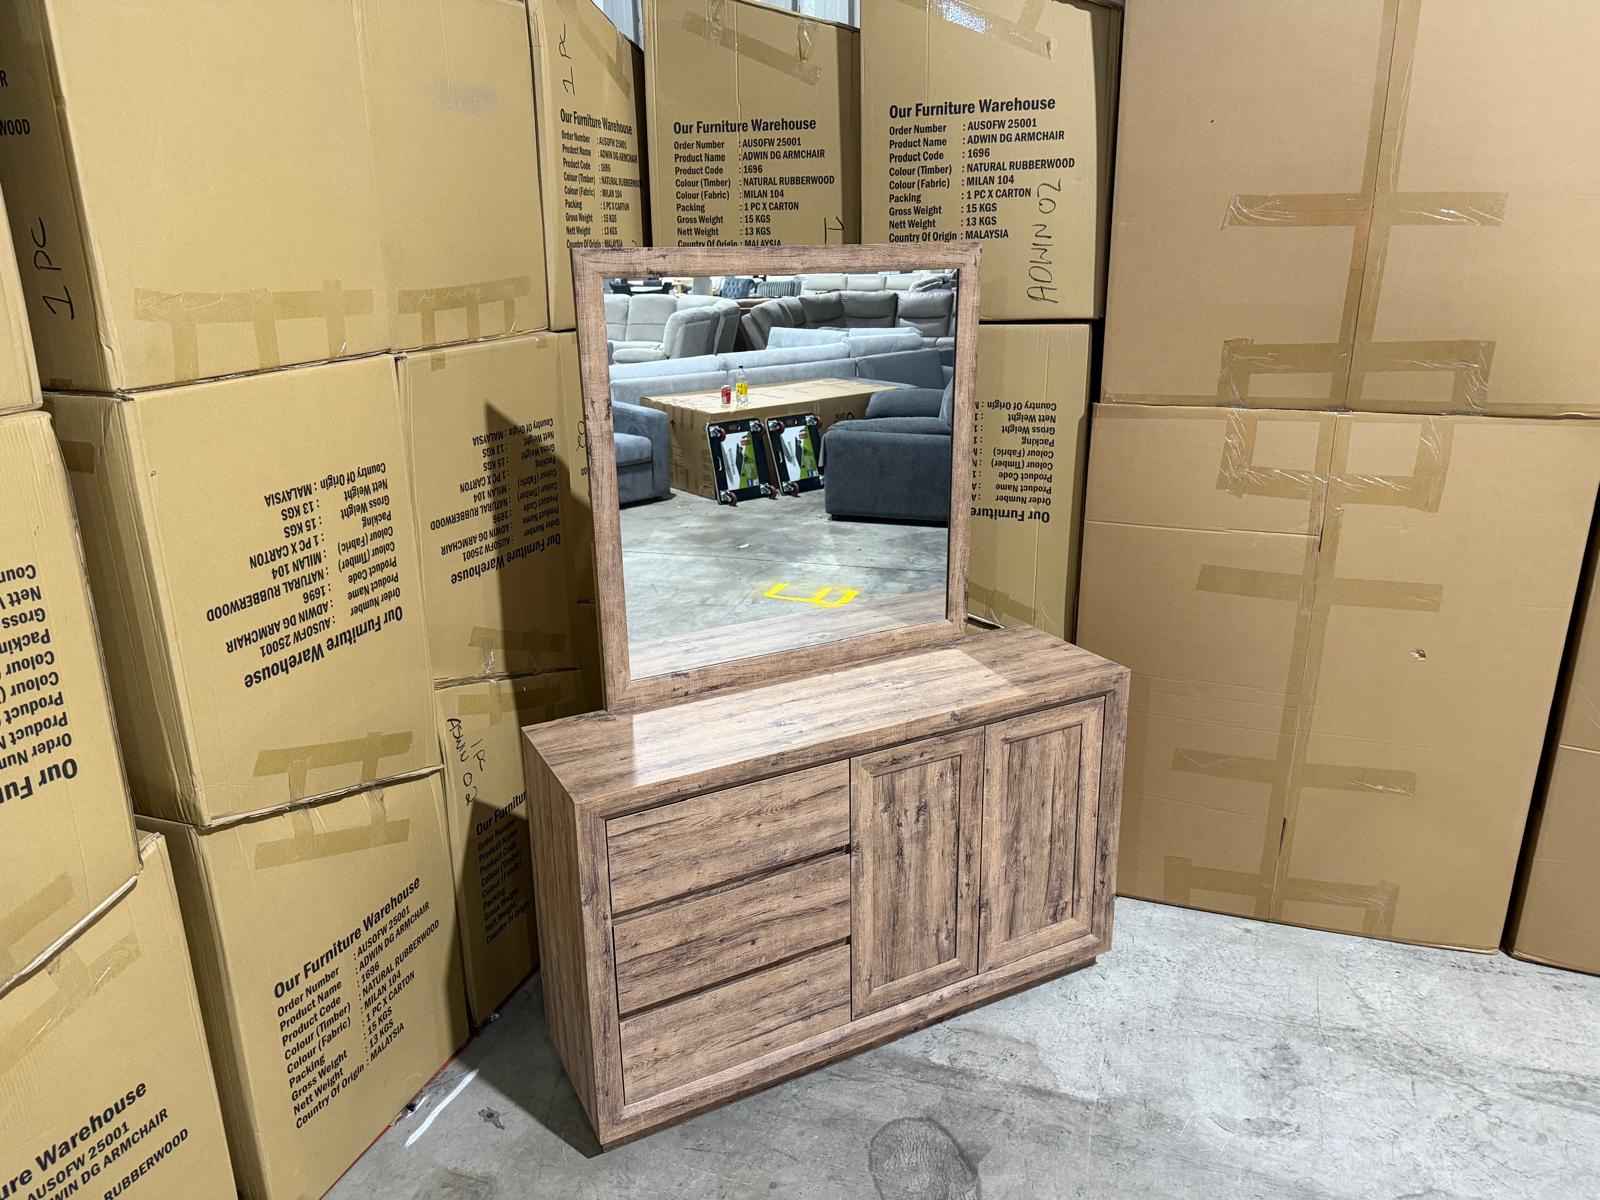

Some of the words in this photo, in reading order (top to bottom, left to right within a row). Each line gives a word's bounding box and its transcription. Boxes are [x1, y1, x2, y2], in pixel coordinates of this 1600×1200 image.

[889, 104, 912, 119] Our
[915, 101, 975, 117] Furniture
[978, 97, 1055, 113] Warehouse
[560, 108, 572, 123] Our
[573, 110, 601, 129] Furniture
[601, 116, 632, 135] Warehouse
[673, 121, 694, 134] Our
[696, 120, 748, 134] Furniture
[750, 117, 816, 132] Warehouse
[889, 125, 912, 136] Order
[913, 123, 947, 134] Number
[967, 119, 1006, 131] AUSOFW
[1007, 117, 1037, 129] 25001
[673, 140, 694, 150] Order
[695, 140, 725, 149] Number
[742, 138, 775, 148] AUSOFW
[776, 137, 801, 147] 25001
[889, 138, 921, 149] Product
[922, 137, 947, 147] Name
[966, 133, 997, 144] ADWIN
[999, 132, 1012, 143] DG
[1014, 130, 1064, 142] ARMCHAIR
[674, 152, 703, 163] Product
[704, 152, 725, 162] Name
[742, 151, 768, 161] ADWIN
[770, 150, 781, 160] DG
[782, 149, 825, 159] ARMCHAIR
[889, 151, 921, 163] Product
[922, 150, 944, 161] Code
[967, 147, 990, 158] 1696
[674, 166, 703, 175] Product
[704, 165, 723, 174] Code
[743, 164, 763, 174] 1696
[889, 166, 916, 177] Colour
[917, 164, 952, 177] (Timber)
[966, 161, 1007, 172] NATURAL
[1009, 157, 1075, 170] RUBBERWOOD
[675, 178, 699, 188] Colour
[700, 178, 731, 189] (Timber)
[743, 176, 778, 186] NATURAL
[779, 175, 835, 186] RUBBERWOOD
[888, 180, 916, 190] Colour
[916, 177, 950, 190] (Fabric)
[966, 175, 995, 186] MILAN
[997, 174, 1014, 184] 104
[675, 190, 699, 200] Colour
[700, 190, 730, 201] (Fabric)
[743, 189, 768, 198] MILAN
[770, 189, 784, 198] 104
[889, 192, 922, 204] Packing
[966, 190, 972, 200] 1
[974, 189, 986, 199] PC
[987, 189, 993, 199] X
[995, 187, 1031, 198] CARTON
[888, 206, 912, 216] Gross
[913, 205, 942, 216] Weight
[966, 203, 977, 213] 15
[979, 202, 997, 212] KGS
[676, 215, 697, 224] Gross
[698, 215, 724, 226] Weight
[744, 214, 754, 223] 15
[755, 214, 771, 223] KGS
[888, 219, 906, 229] Nett
[907, 218, 936, 230] Weight
[966, 216, 977, 226] 13
[979, 216, 997, 226] KGS
[31, 217, 61, 271] PC
[888, 232, 920, 243] Country
[921, 231, 931, 242] Of
[932, 231, 957, 243] Origin
[965, 229, 1009, 239] MALAYSIA
[987, 400, 1011, 411] Origin
[1012, 402, 1023, 411] Of
[1024, 401, 1057, 411] Country
[993, 447, 1025, 458] (Fabric)
[1026, 449, 1054, 458] Colour
[459, 476, 486, 492] CARTON
[998, 471, 1019, 481] Code
[1021, 473, 1053, 483] Product
[995, 483, 1019, 492] Name
[1020, 484, 1052, 494] Product
[996, 494, 1027, 504] Number
[1028, 497, 1051, 506] Order
[430, 506, 479, 530] RUBBERWOOD
[970, 507, 1025, 522] Furniture
[1027, 511, 1050, 523] Our
[369, 525, 393, 541] Colour
[478, 530, 488, 542] DG
[337, 532, 368, 555] (Fabric)
[371, 540, 395, 557] Colour
[440, 534, 477, 555] ARMCHAIR
[292, 551, 322, 572] MILAN
[338, 548, 370, 573] (Timber)
[462, 545, 483, 562] 25001
[271, 563, 290, 580] 104
[347, 568, 368, 584] Code
[368, 556, 397, 577] Product
[450, 554, 505, 584] Warehouse
[281, 568, 324, 593] NATURAL
[370, 571, 399, 592] Product
[8, 586, 42, 607] Nett
[302, 585, 326, 604] 1696
[347, 584, 370, 600] Name
[380, 586, 400, 602] Order
[206, 584, 281, 622] RUBBERWOOD
[298, 600, 328, 623] ADWIN
[350, 596, 380, 616] Number
[2, 607, 46, 629] Gross
[282, 614, 297, 629] DG
[383, 605, 402, 624] Our
[225, 620, 280, 653] ARMCHAIR
[293, 617, 330, 644] AUSOFW
[326, 615, 381, 651] Furniture
[259, 634, 291, 657] 25001
[5, 651, 55, 676] Colour
[244, 643, 324, 688] Warehouse
[10, 671, 60, 696] Colour
[4, 691, 65, 725] Product
[10, 711, 69, 745] Product
[31, 732, 73, 757] Order
[38, 758, 78, 787] Our
[476, 815, 492, 836] Our
[274, 972, 300, 998] Our
[303, 927, 361, 979] Furniture
[362, 877, 420, 932] Warehouse
[277, 993, 304, 1017] Order
[305, 967, 339, 998] Number
[357, 924, 387, 957] AUSOFW
[388, 905, 410, 930] 25001
[279, 998, 316, 1032] Product
[317, 981, 342, 1004] Name
[359, 942, 383, 971] ADWIN
[384, 932, 394, 948] DG
[395, 901, 430, 938] ARMCHAIR
[284, 1031, 314, 1060] Colour
[316, 1002, 350, 1037] (Timber)
[362, 963, 394, 997] NATURAL
[394, 919, 439, 968] RUBBERWOOD
[296, 1094, 329, 1129] Country
[330, 1083, 340, 1098] Of
[341, 1064, 364, 1088] Origin
[370, 1022, 404, 1061] MALAYSIA
[35, 1082, 147, 1172] Warehouse
[81, 1163, 101, 1185] DG
[103, 1108, 168, 1169] ARMCHAIR
[88, 1122, 130, 1161] 25001
[104, 1128, 188, 1200] RUBBERWOOD
